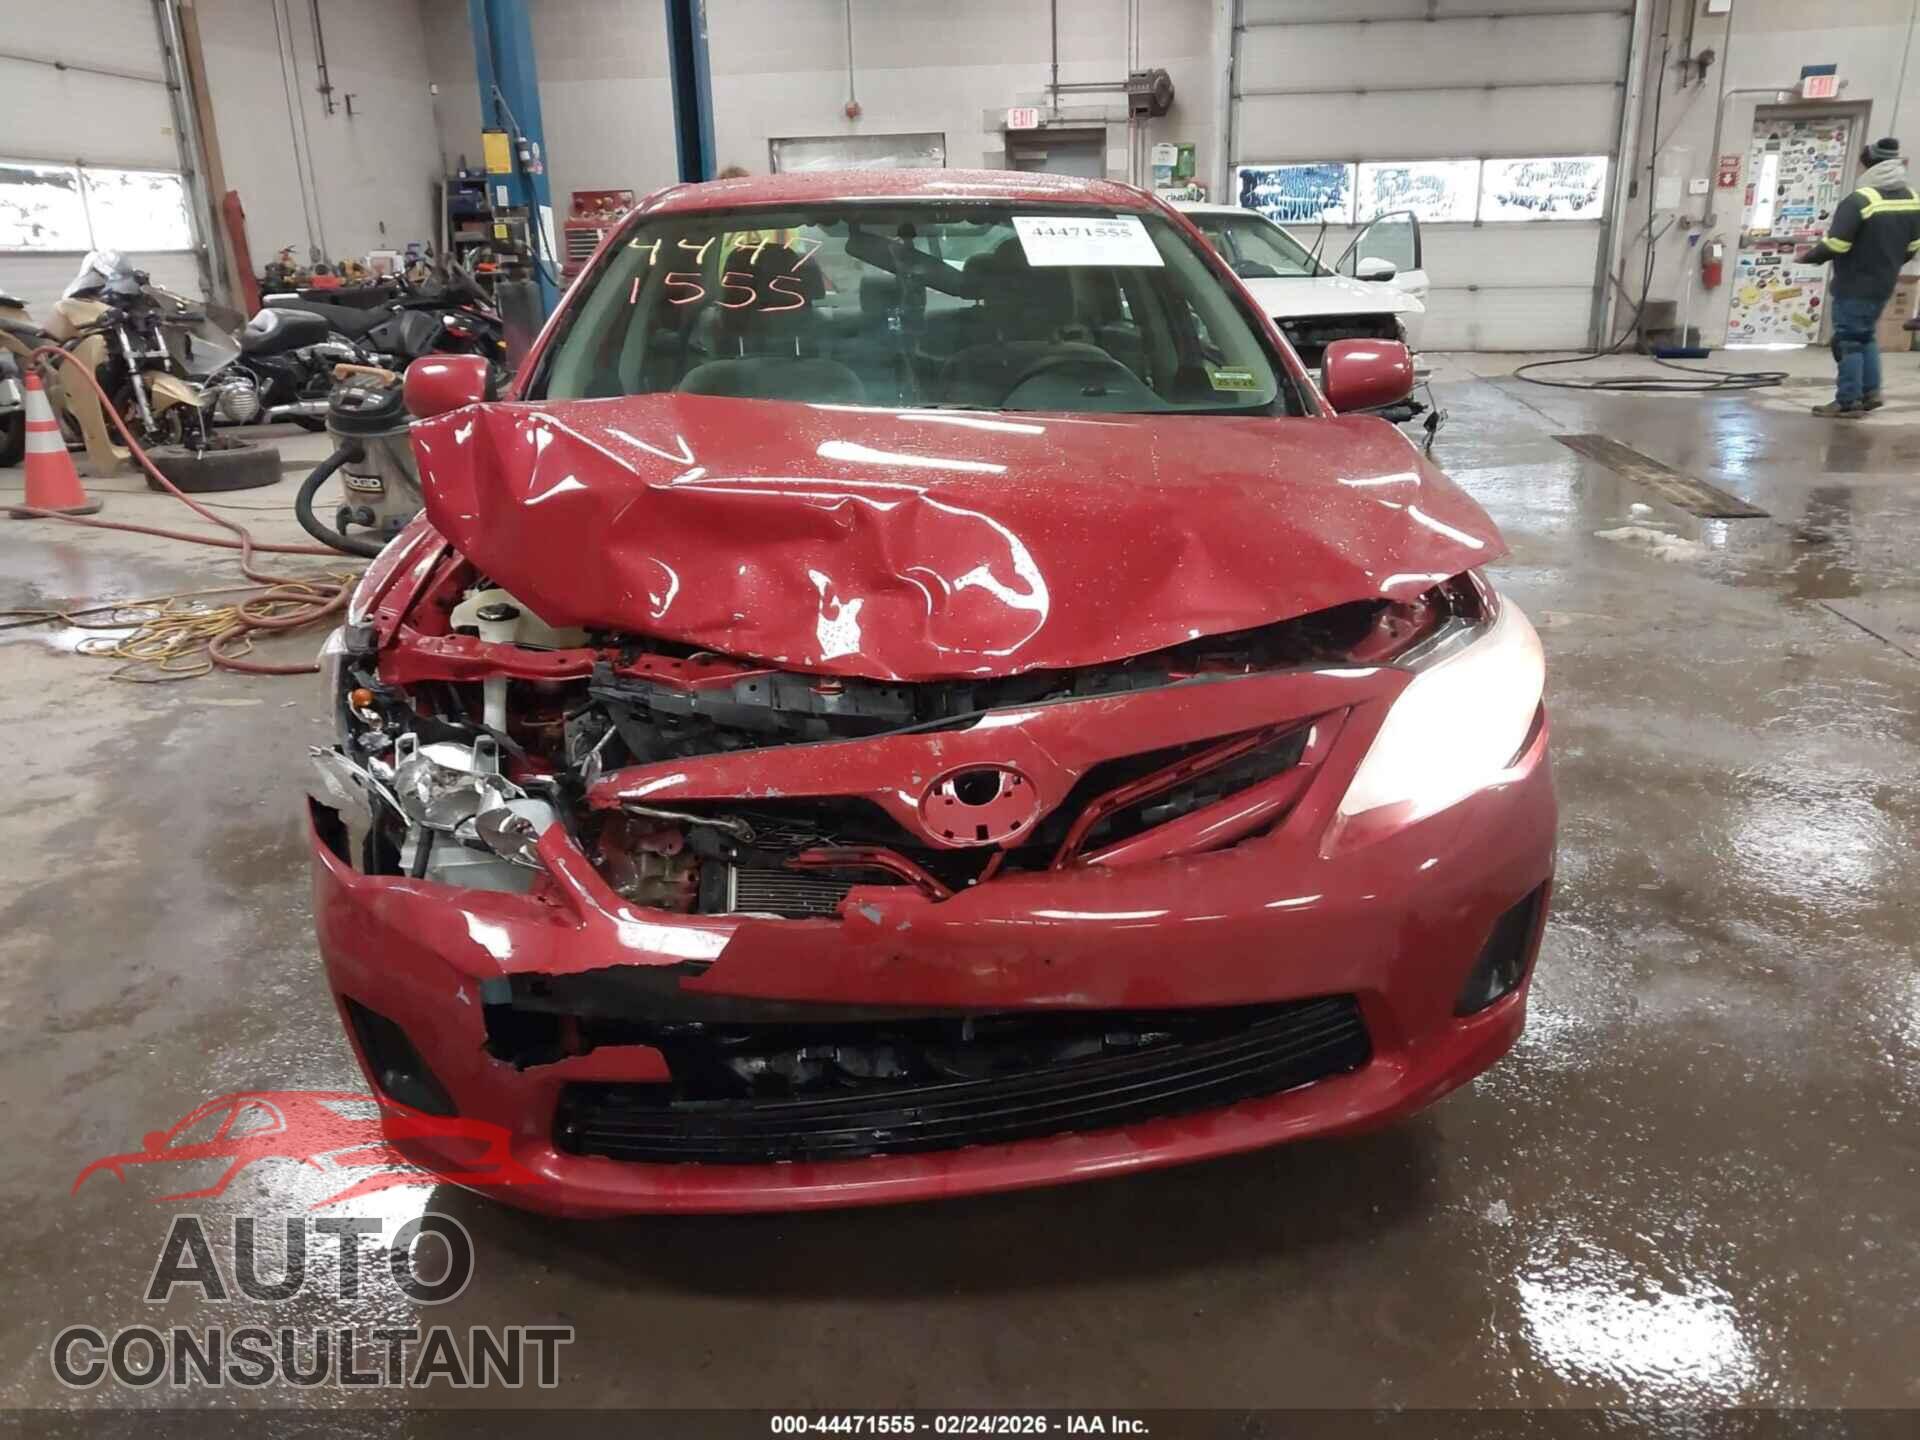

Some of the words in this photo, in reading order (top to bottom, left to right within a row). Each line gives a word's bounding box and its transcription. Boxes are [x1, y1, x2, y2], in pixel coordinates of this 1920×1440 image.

[1012, 110, 1034, 126] EXIT
[1031, 226, 1133, 238] 44471555
[628, 235, 823, 273] 4447
[628, 271, 806, 312] 1555
